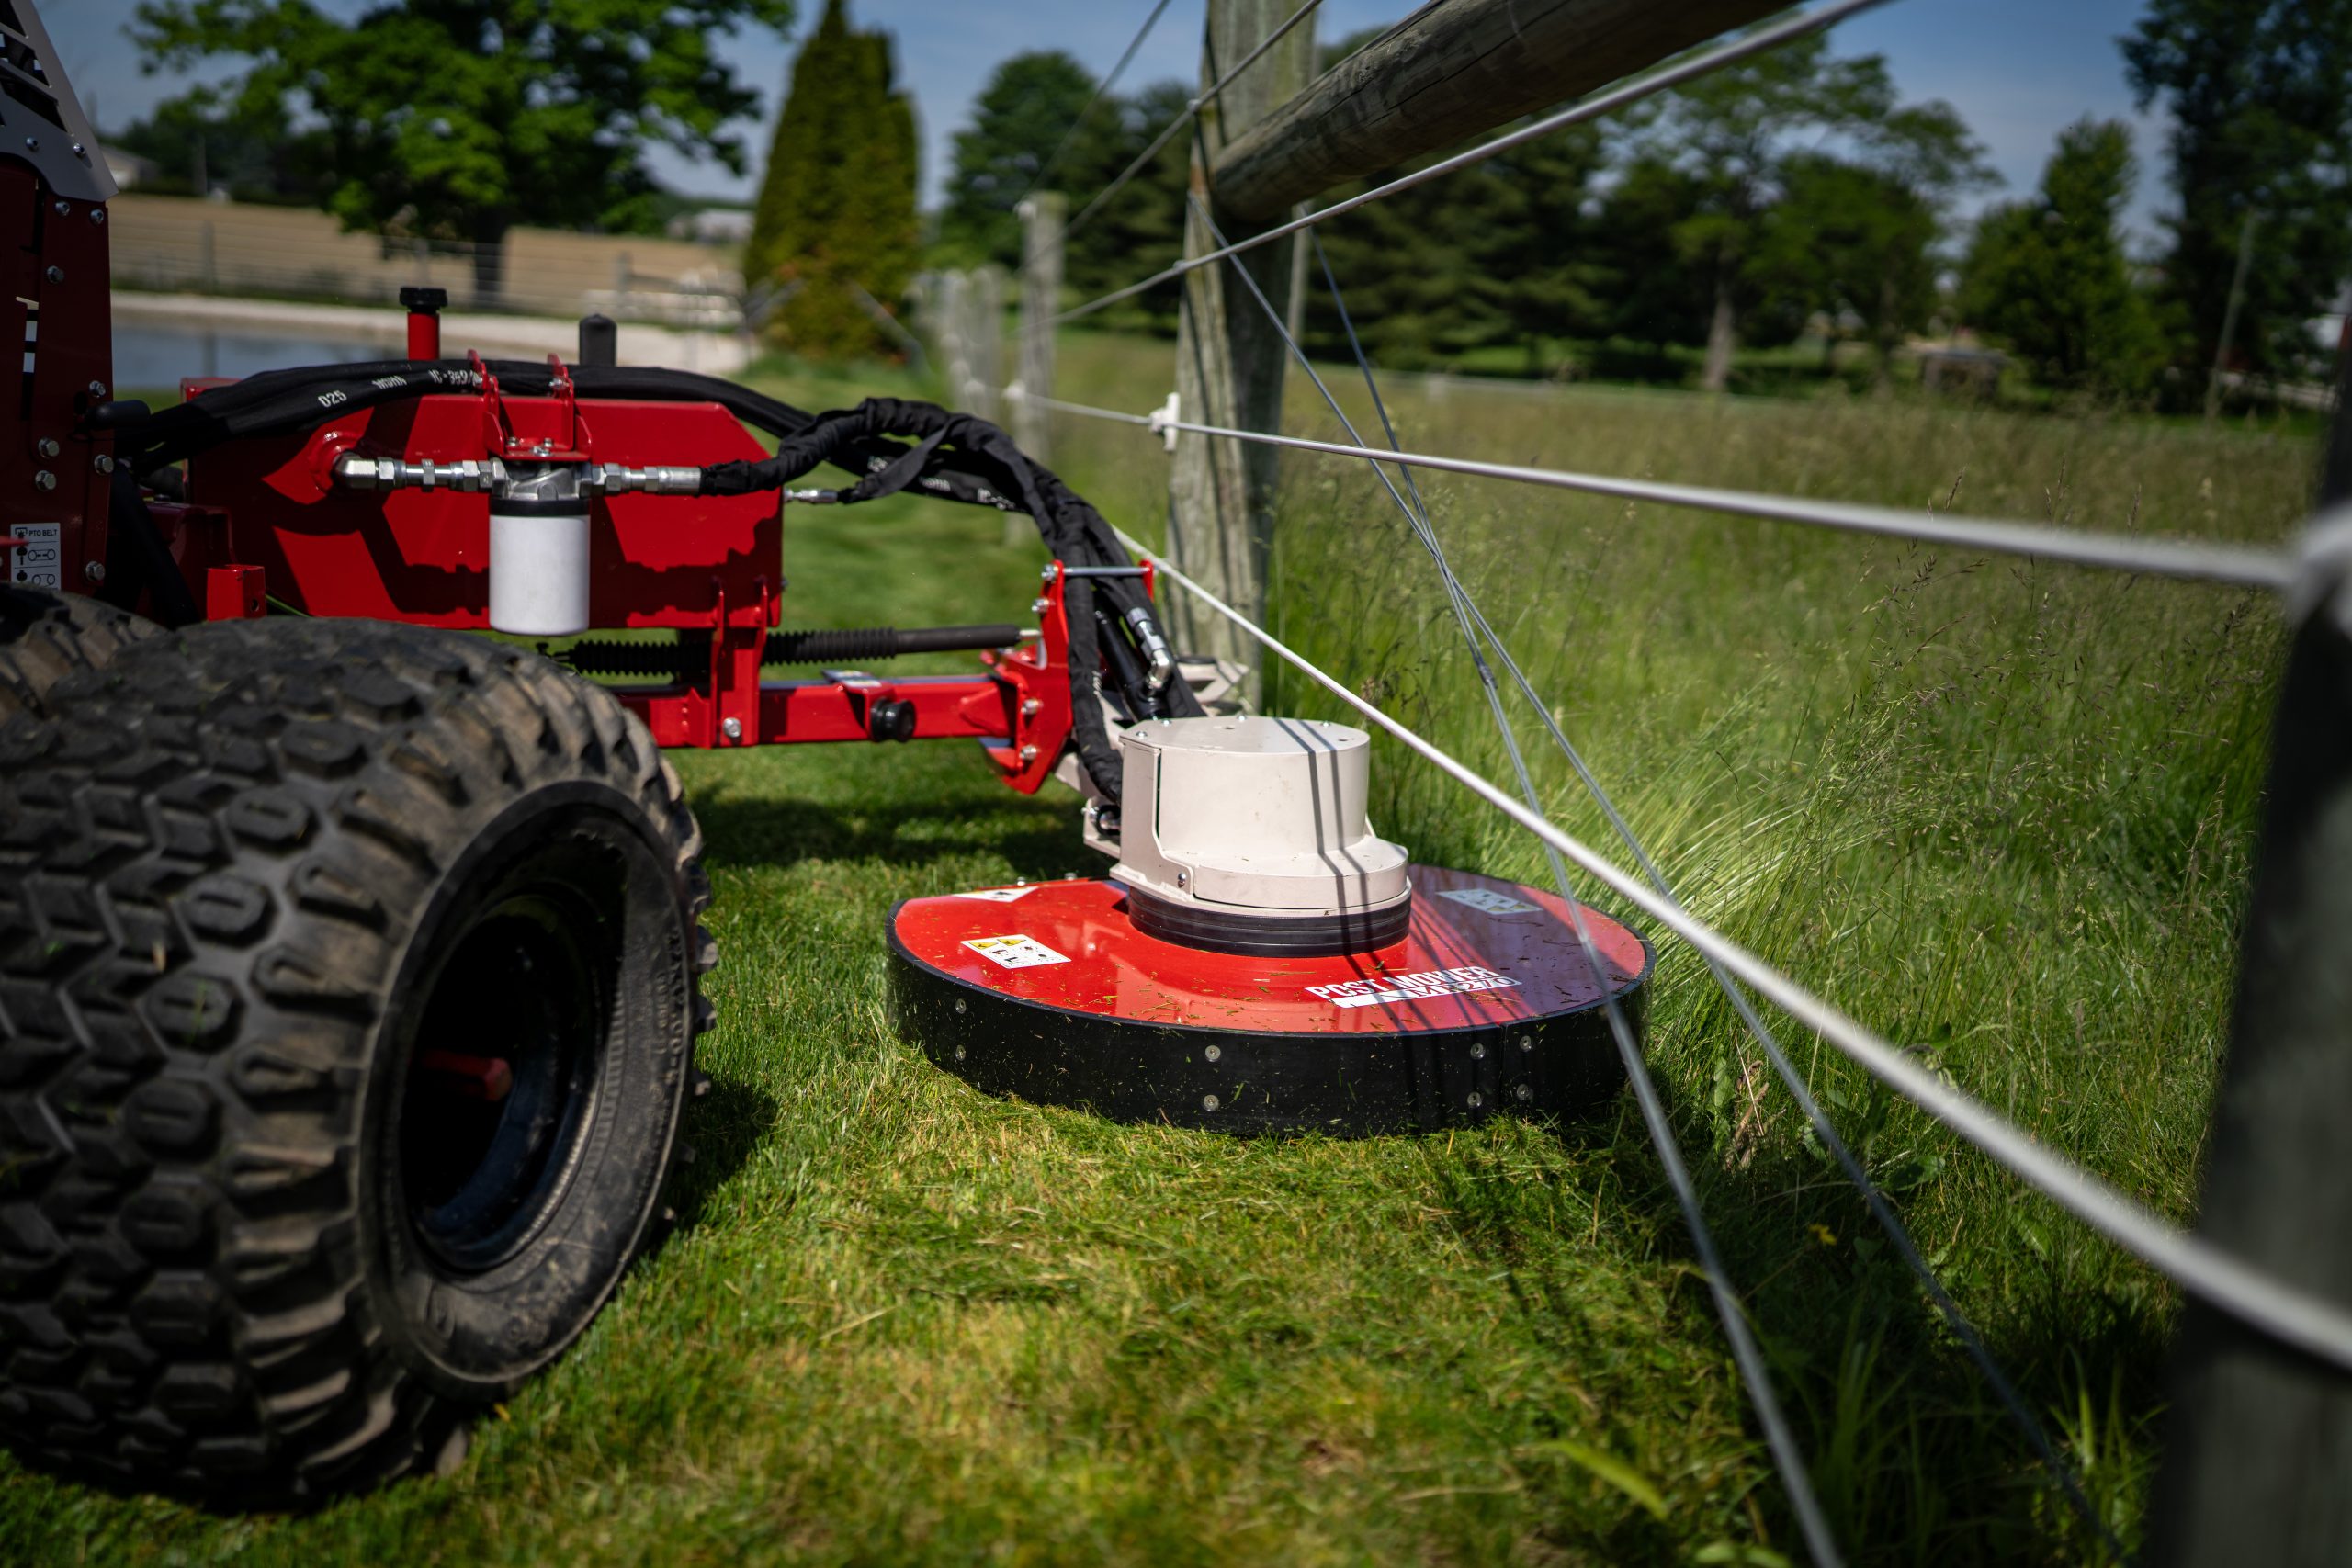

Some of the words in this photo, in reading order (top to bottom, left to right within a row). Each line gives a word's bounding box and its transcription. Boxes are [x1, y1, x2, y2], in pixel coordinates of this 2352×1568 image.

[42, 528, 57, 536] BELT
[1305, 979, 1389, 999] POST
[1382, 966, 1501, 990] MOWER
